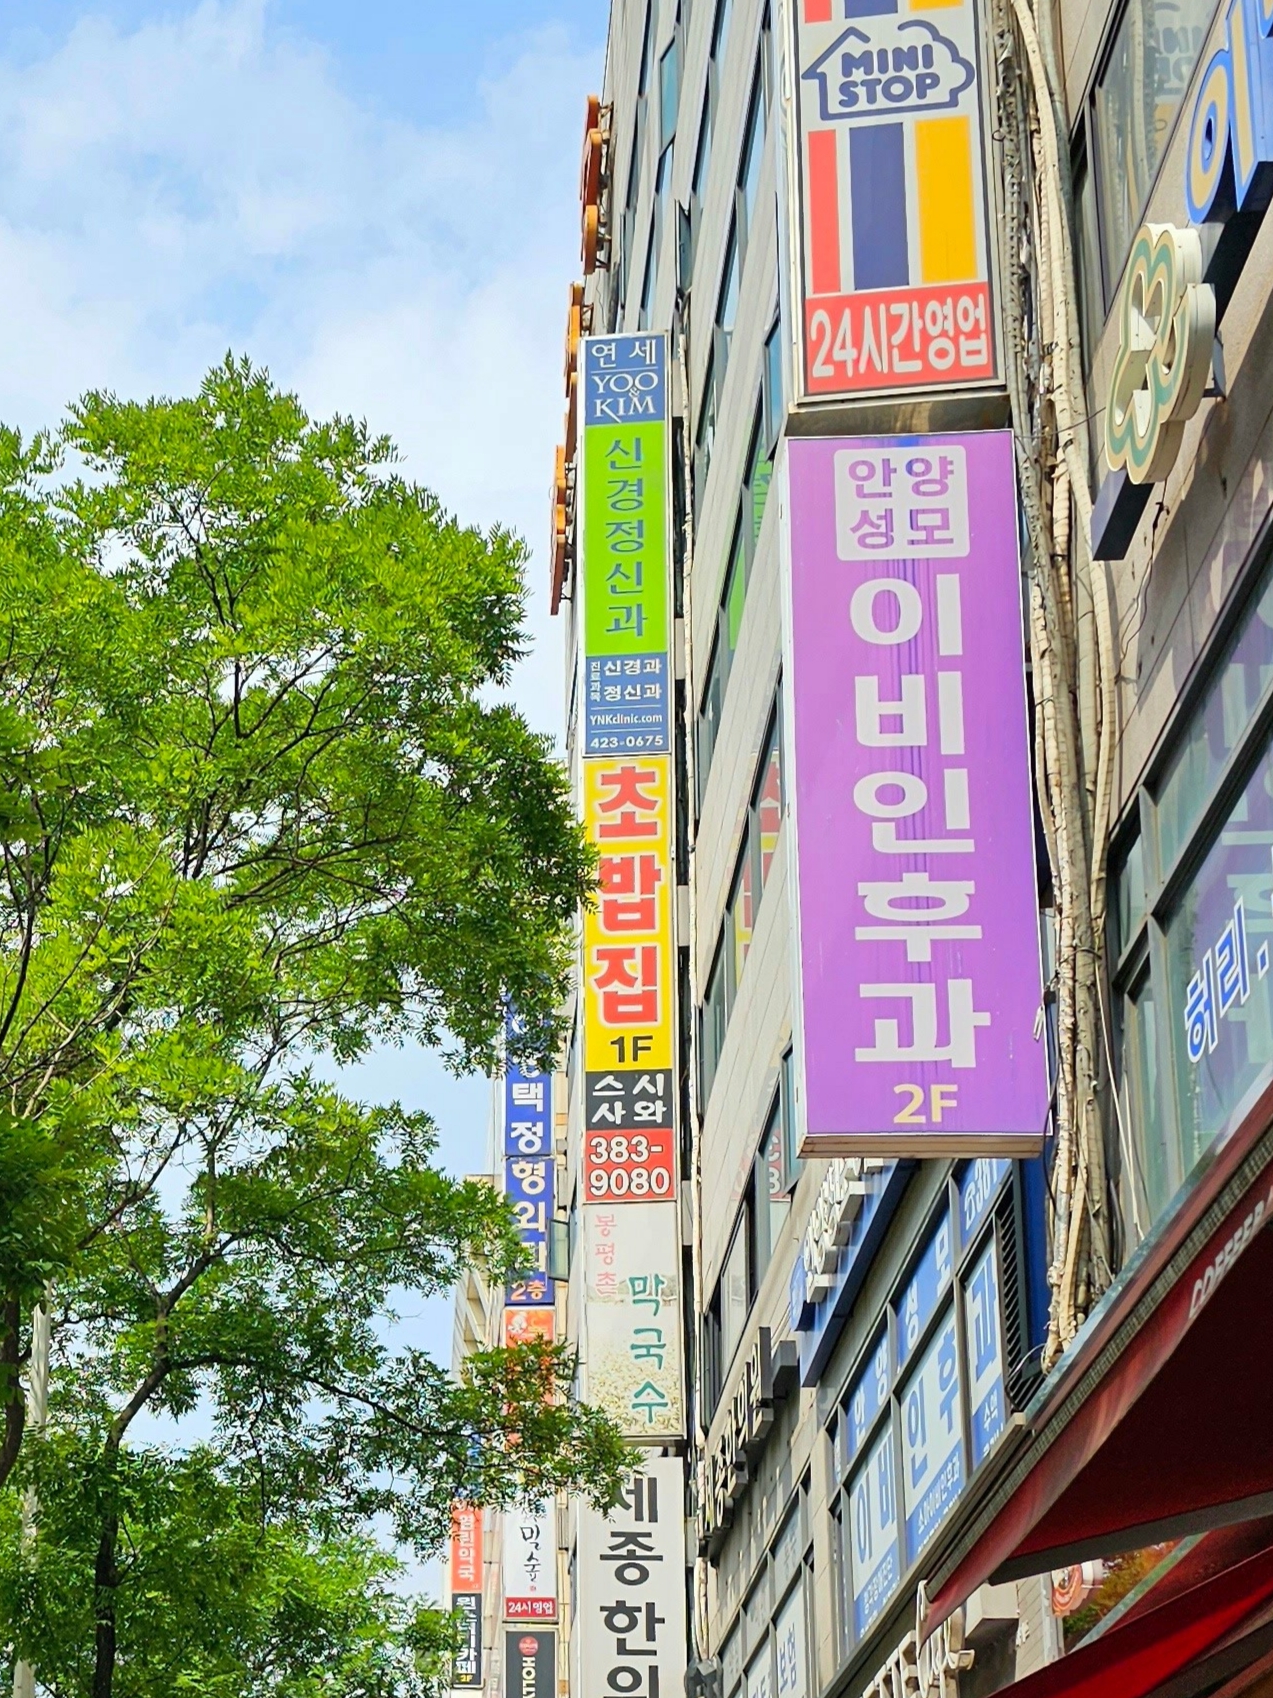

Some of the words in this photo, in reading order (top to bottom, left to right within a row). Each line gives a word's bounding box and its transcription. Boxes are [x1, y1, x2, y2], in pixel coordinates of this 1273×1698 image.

[842, 44, 933, 78] MINI
[838, 72, 940, 107] STOP
[810, 294, 987, 378] 24시간영업
[592, 339, 657, 368] 연세
[591, 371, 658, 393] YOO
[594, 395, 656, 423] KIM
[848, 455, 955, 499] 안양
[605, 437, 648, 637] 신경정신과
[849, 507, 955, 550] 성모
[604, 658, 662, 676] 신경과
[604, 683, 662, 701] 정신과
[590, 736, 664, 749] 423-0675
[850, 573, 991, 1068] 이비인후과
[594, 766, 661, 1023] 초밥집
[610, 1036, 654, 1063] 1F
[592, 1073, 665, 1097] 스시
[591, 1100, 667, 1125] 사와
[893, 1084, 958, 1124] 2F
[589, 1135, 664, 1165] 383-
[589, 1166, 671, 1197] 9080
[510, 1279, 547, 1300] 2층
[627, 1272, 668, 1425] 막국수
